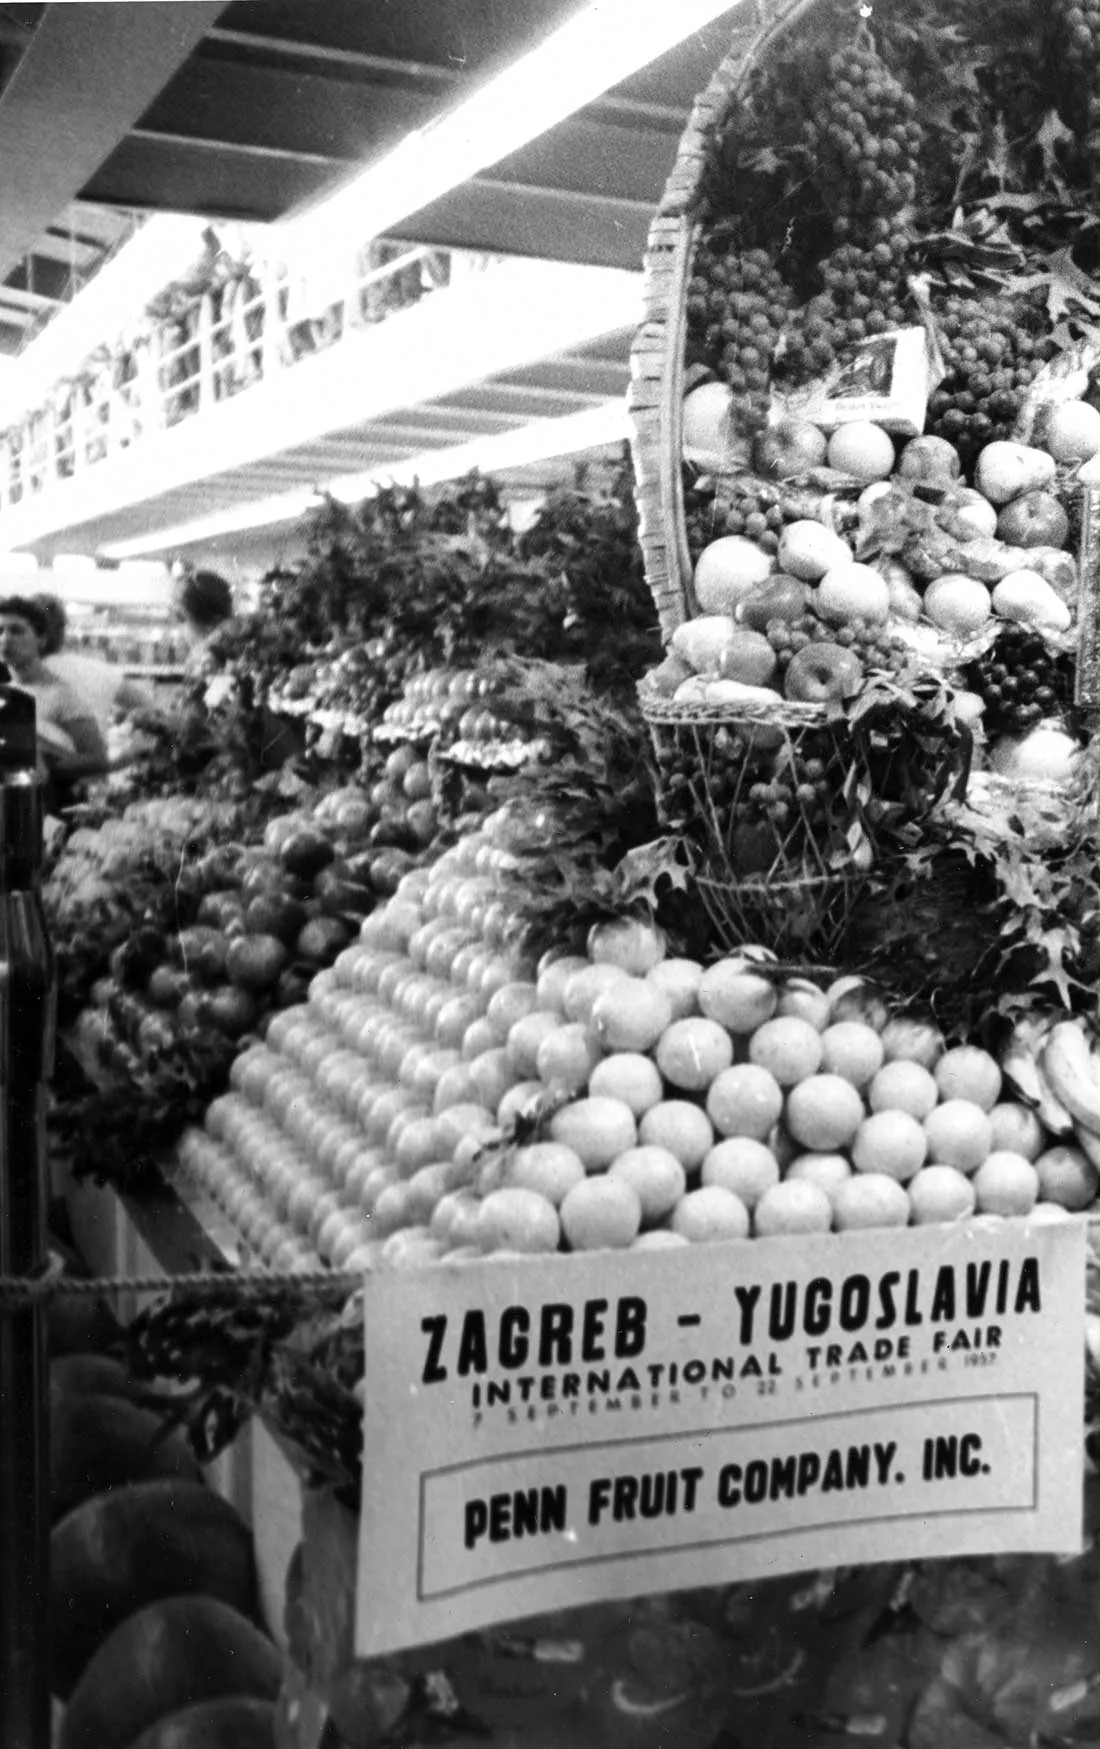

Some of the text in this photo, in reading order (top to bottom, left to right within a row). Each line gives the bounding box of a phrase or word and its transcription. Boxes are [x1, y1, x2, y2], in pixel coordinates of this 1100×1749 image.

[420, 1295, 648, 1385] ZAGREB
[734, 1257, 1042, 1346] YUGOSLAVIA
[472, 1325, 1003, 1411] INTERNATIONAL TRADE FAIR
[472, 1351, 997, 1430] 7 SEPTEMBER TO 22 SEPTEMBER 1957
[464, 1483, 568, 1550] PENN
[587, 1466, 705, 1528] FRUIT
[922, 1432, 992, 1482] INC.
